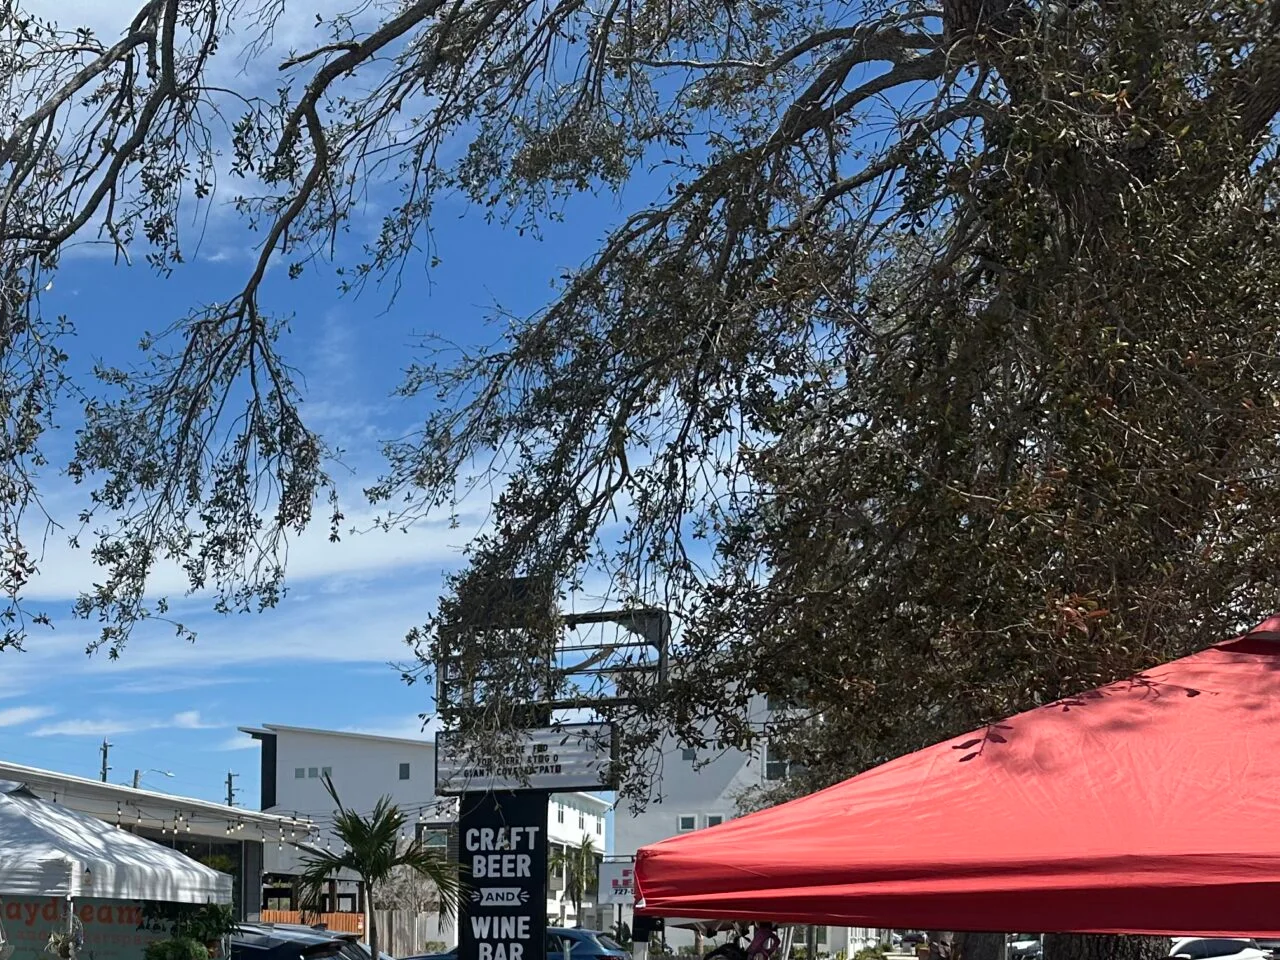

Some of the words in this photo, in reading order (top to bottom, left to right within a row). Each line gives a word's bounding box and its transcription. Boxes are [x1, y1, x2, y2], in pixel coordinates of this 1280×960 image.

[466, 826, 540, 851] CRAFT
[473, 854, 531, 878] BEER
[485, 891, 515, 902] AND
[471, 916, 531, 940] WINE
